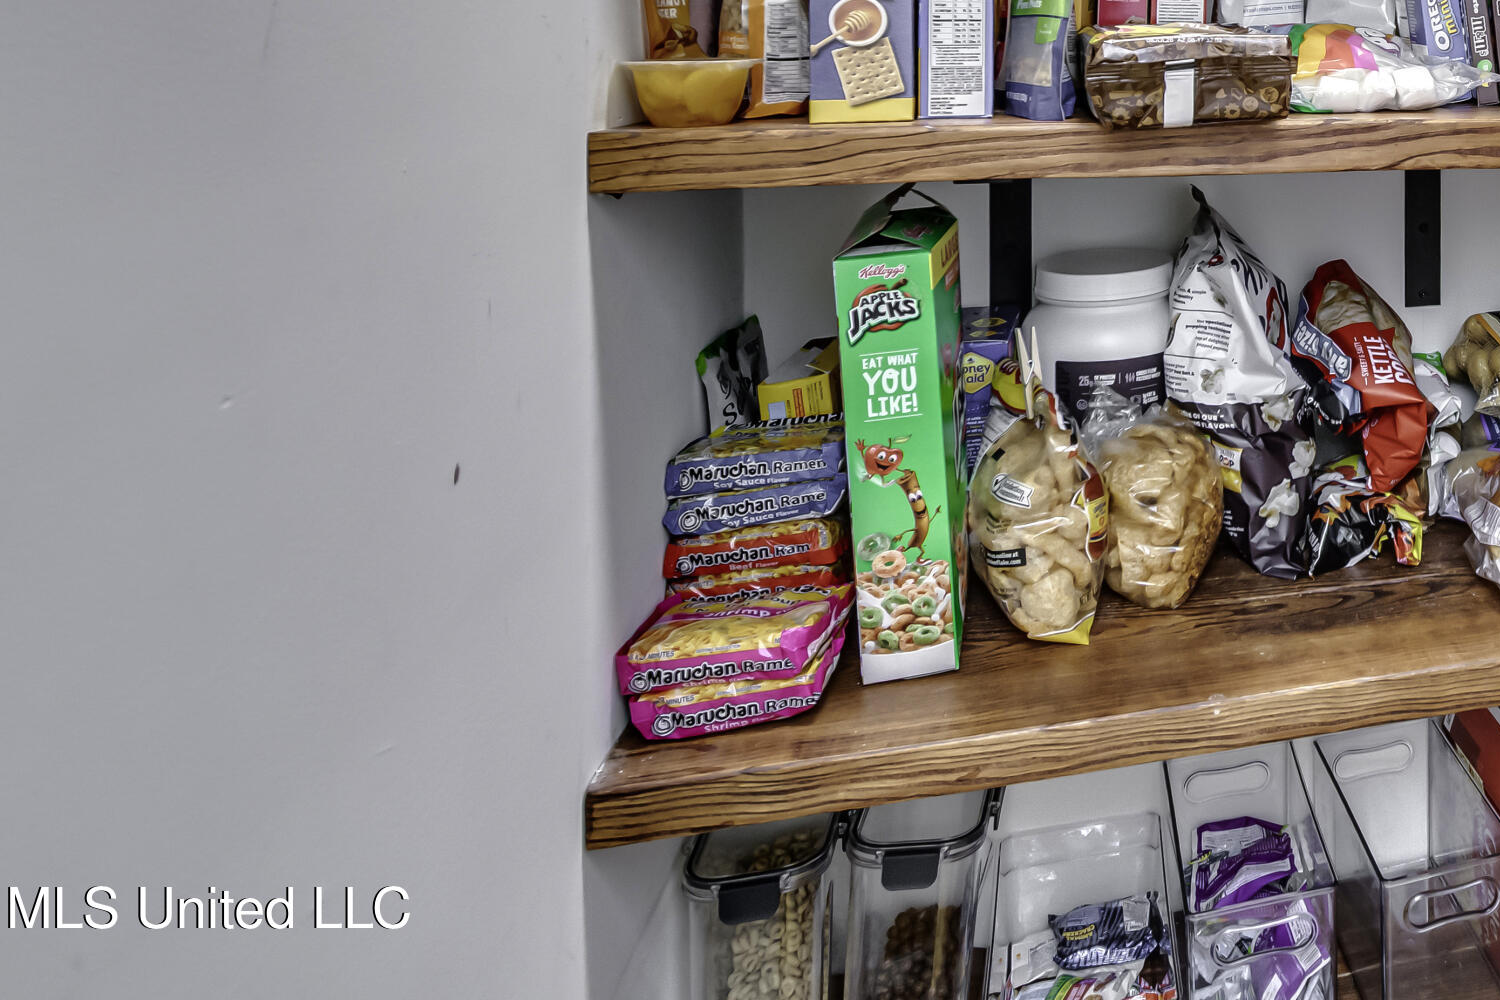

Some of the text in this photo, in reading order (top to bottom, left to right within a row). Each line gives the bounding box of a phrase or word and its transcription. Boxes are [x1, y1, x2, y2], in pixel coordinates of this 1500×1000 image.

[1441, 0, 1459, 35] mini
[859, 263, 906, 280] Kellogg's
[860, 291, 902, 307] APPLE
[849, 300, 919, 342] JACKS
[862, 352, 917, 369] EAT WHAT
[1364, 336, 1395, 384] KETTLE
[863, 366, 918, 396] YOU
[867, 391, 918, 418] LIKE!
[689, 459, 827, 482] Maruchan Ramen
[735, 477, 765, 485] Sauce
[696, 499, 777, 521] Maruchan
[742, 513, 774, 524] Sauce
[690, 547, 772, 566] Maruchan
[646, 664, 736, 687] Maruchan
[671, 703, 764, 728] Maruchan
[704, 720, 747, 732] Shrimp
